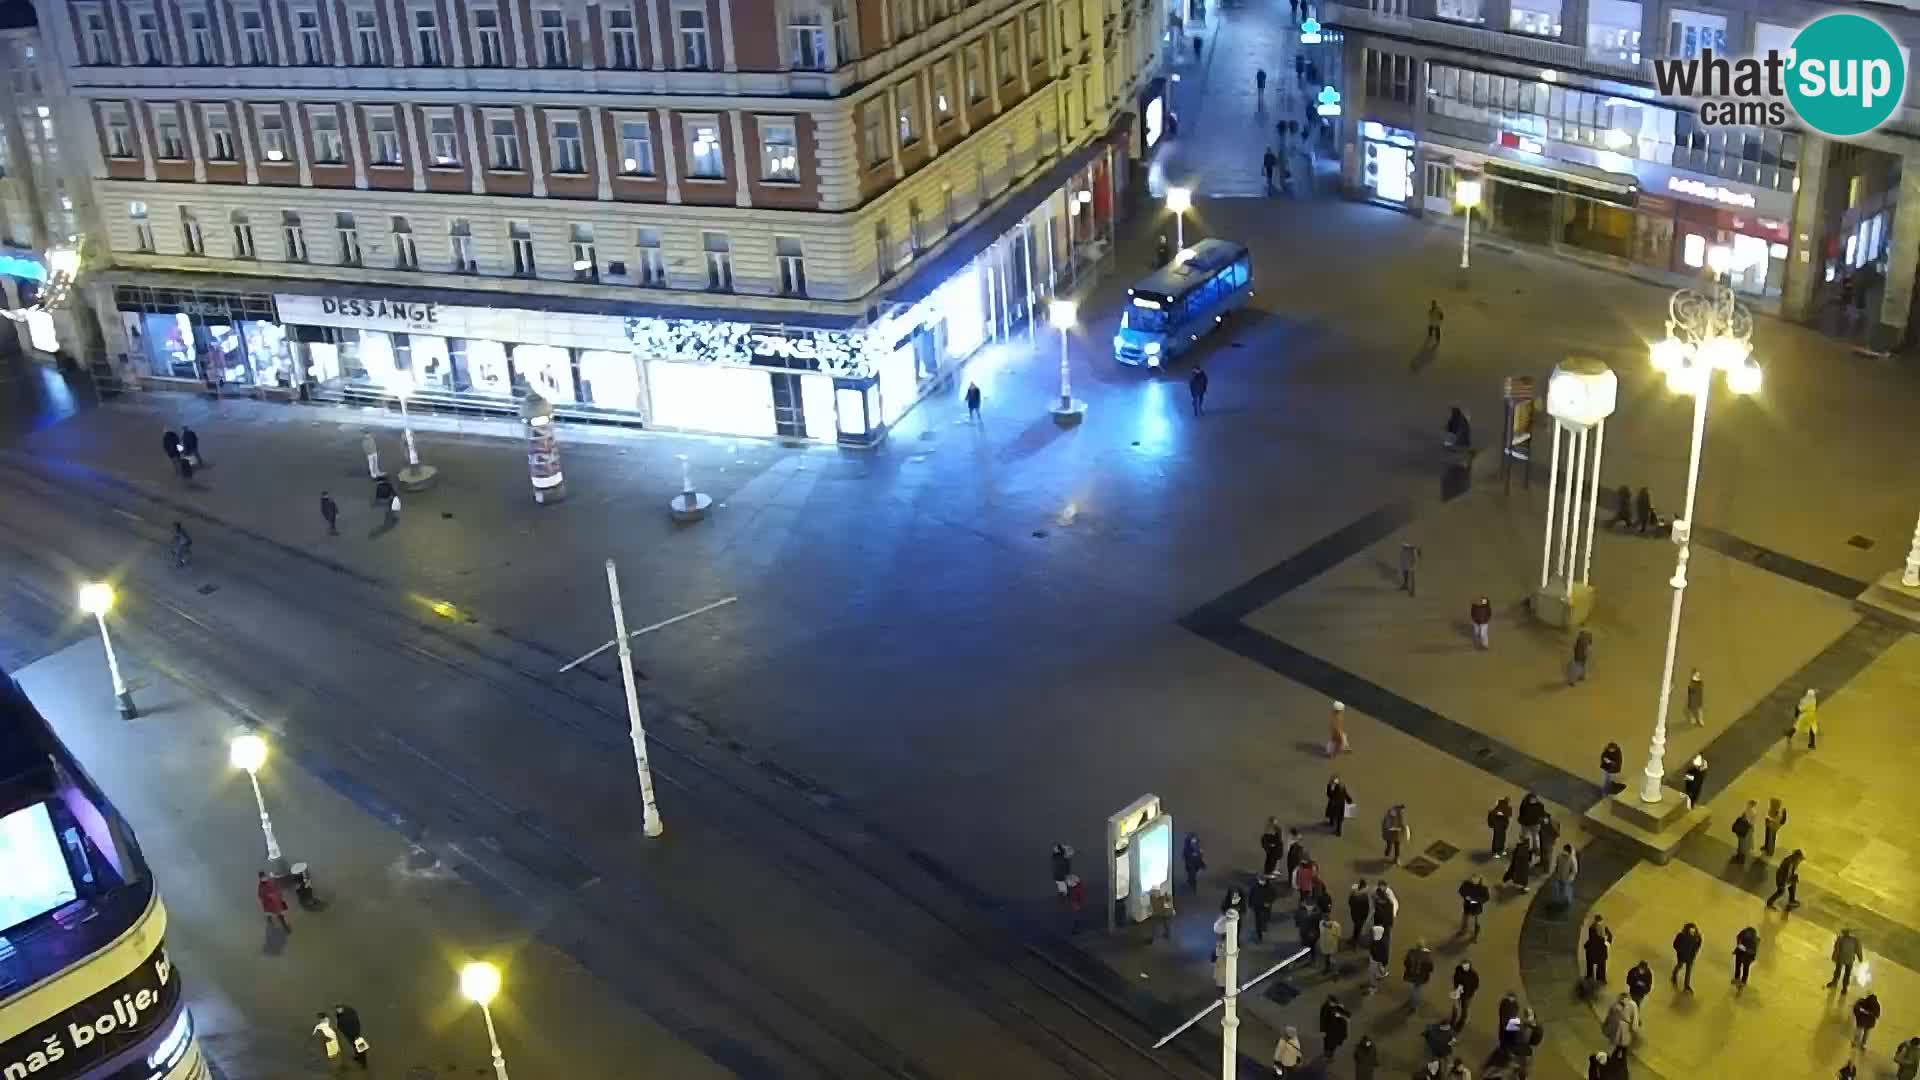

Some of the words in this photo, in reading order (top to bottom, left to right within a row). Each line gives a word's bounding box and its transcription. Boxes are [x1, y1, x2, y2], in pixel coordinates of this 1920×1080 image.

[322, 297, 439, 323] DESSANGE
[3, 1032, 65, 1080] naš
[68, 988, 159, 1049] bolje,
